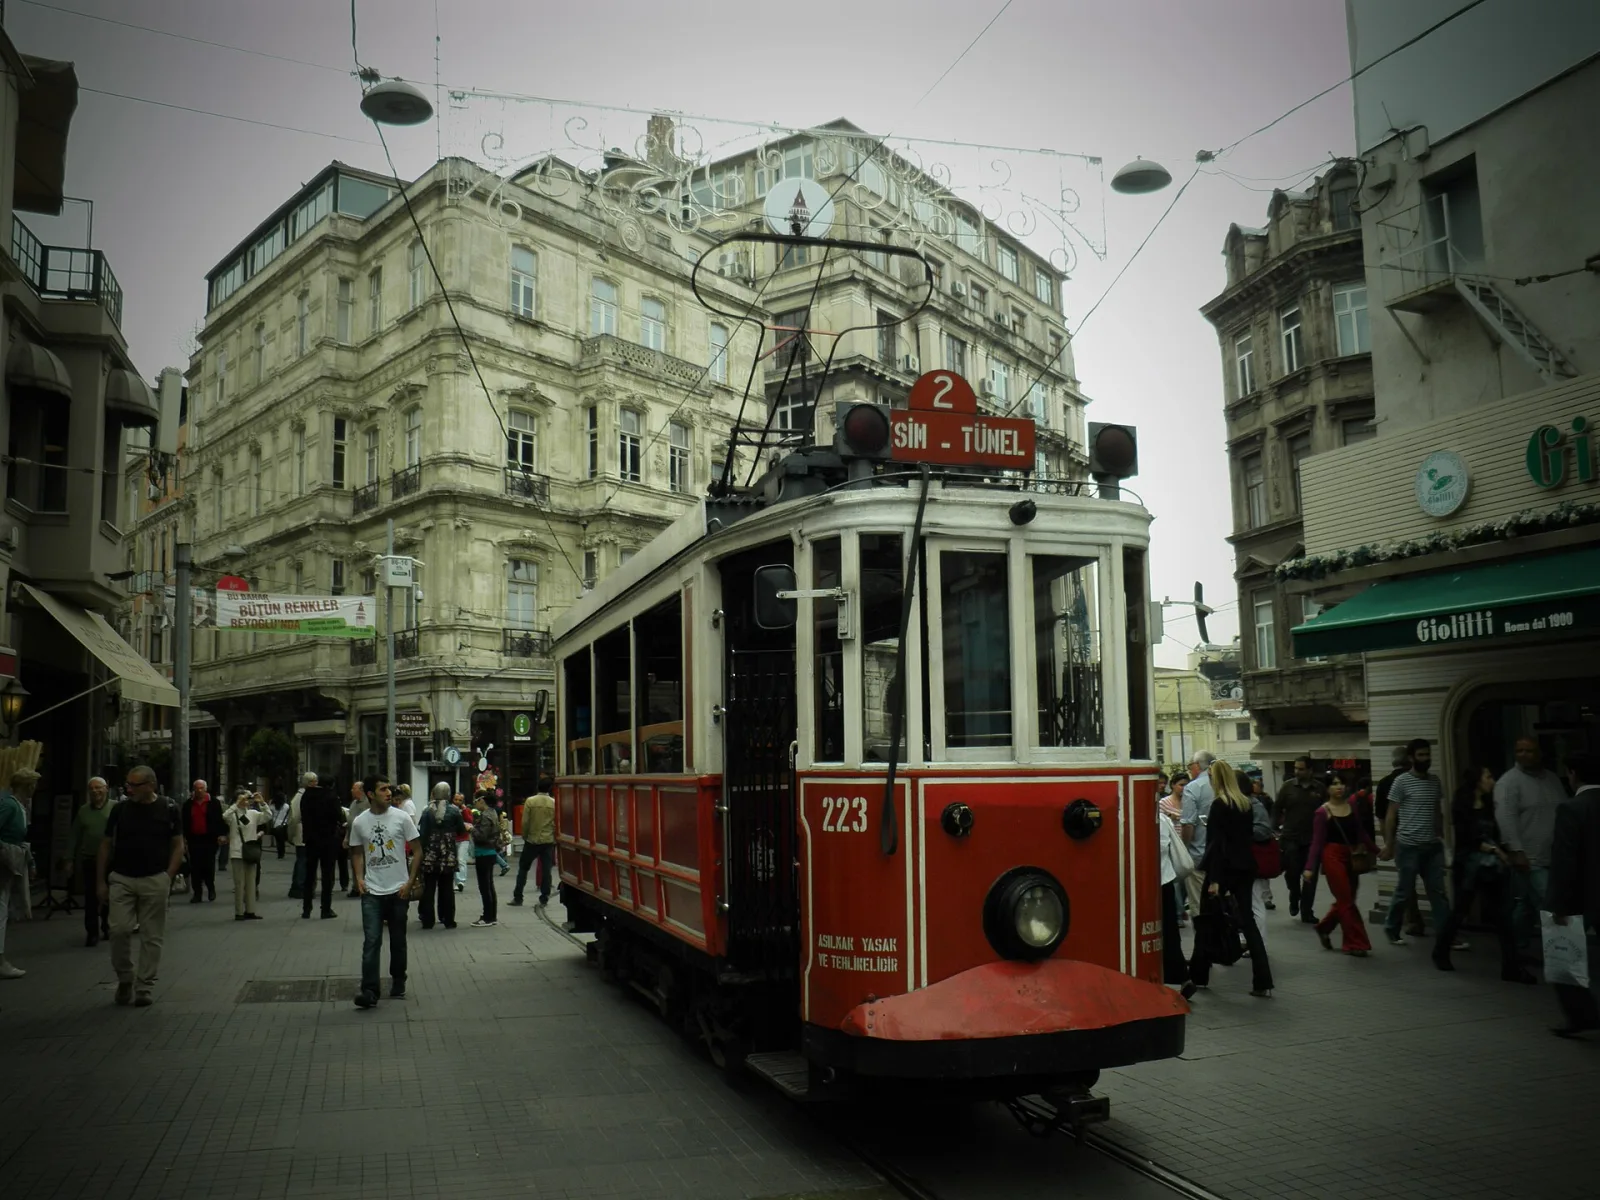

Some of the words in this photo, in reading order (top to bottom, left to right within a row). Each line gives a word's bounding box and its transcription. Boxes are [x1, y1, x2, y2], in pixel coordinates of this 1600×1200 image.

[933, 375, 954, 409] 2
[890, 417, 928, 450] SİM
[961, 422, 1026, 457] TÜNEL
[1526, 415, 1600, 489] Gi
[239, 600, 282, 618] BÜTÜN
[284, 599, 340, 614] RENKLER
[1416, 610, 1494, 643] Giolitti
[1504, 621, 1531, 634] Roma
[1532, 617, 1547, 630] dal
[1549, 611, 1574, 628] 1900
[822, 796, 868, 833] 223
[818, 933, 854, 951] ASILMAK
[861, 937, 898, 952] YASAK
[818, 952, 829, 968] VE
